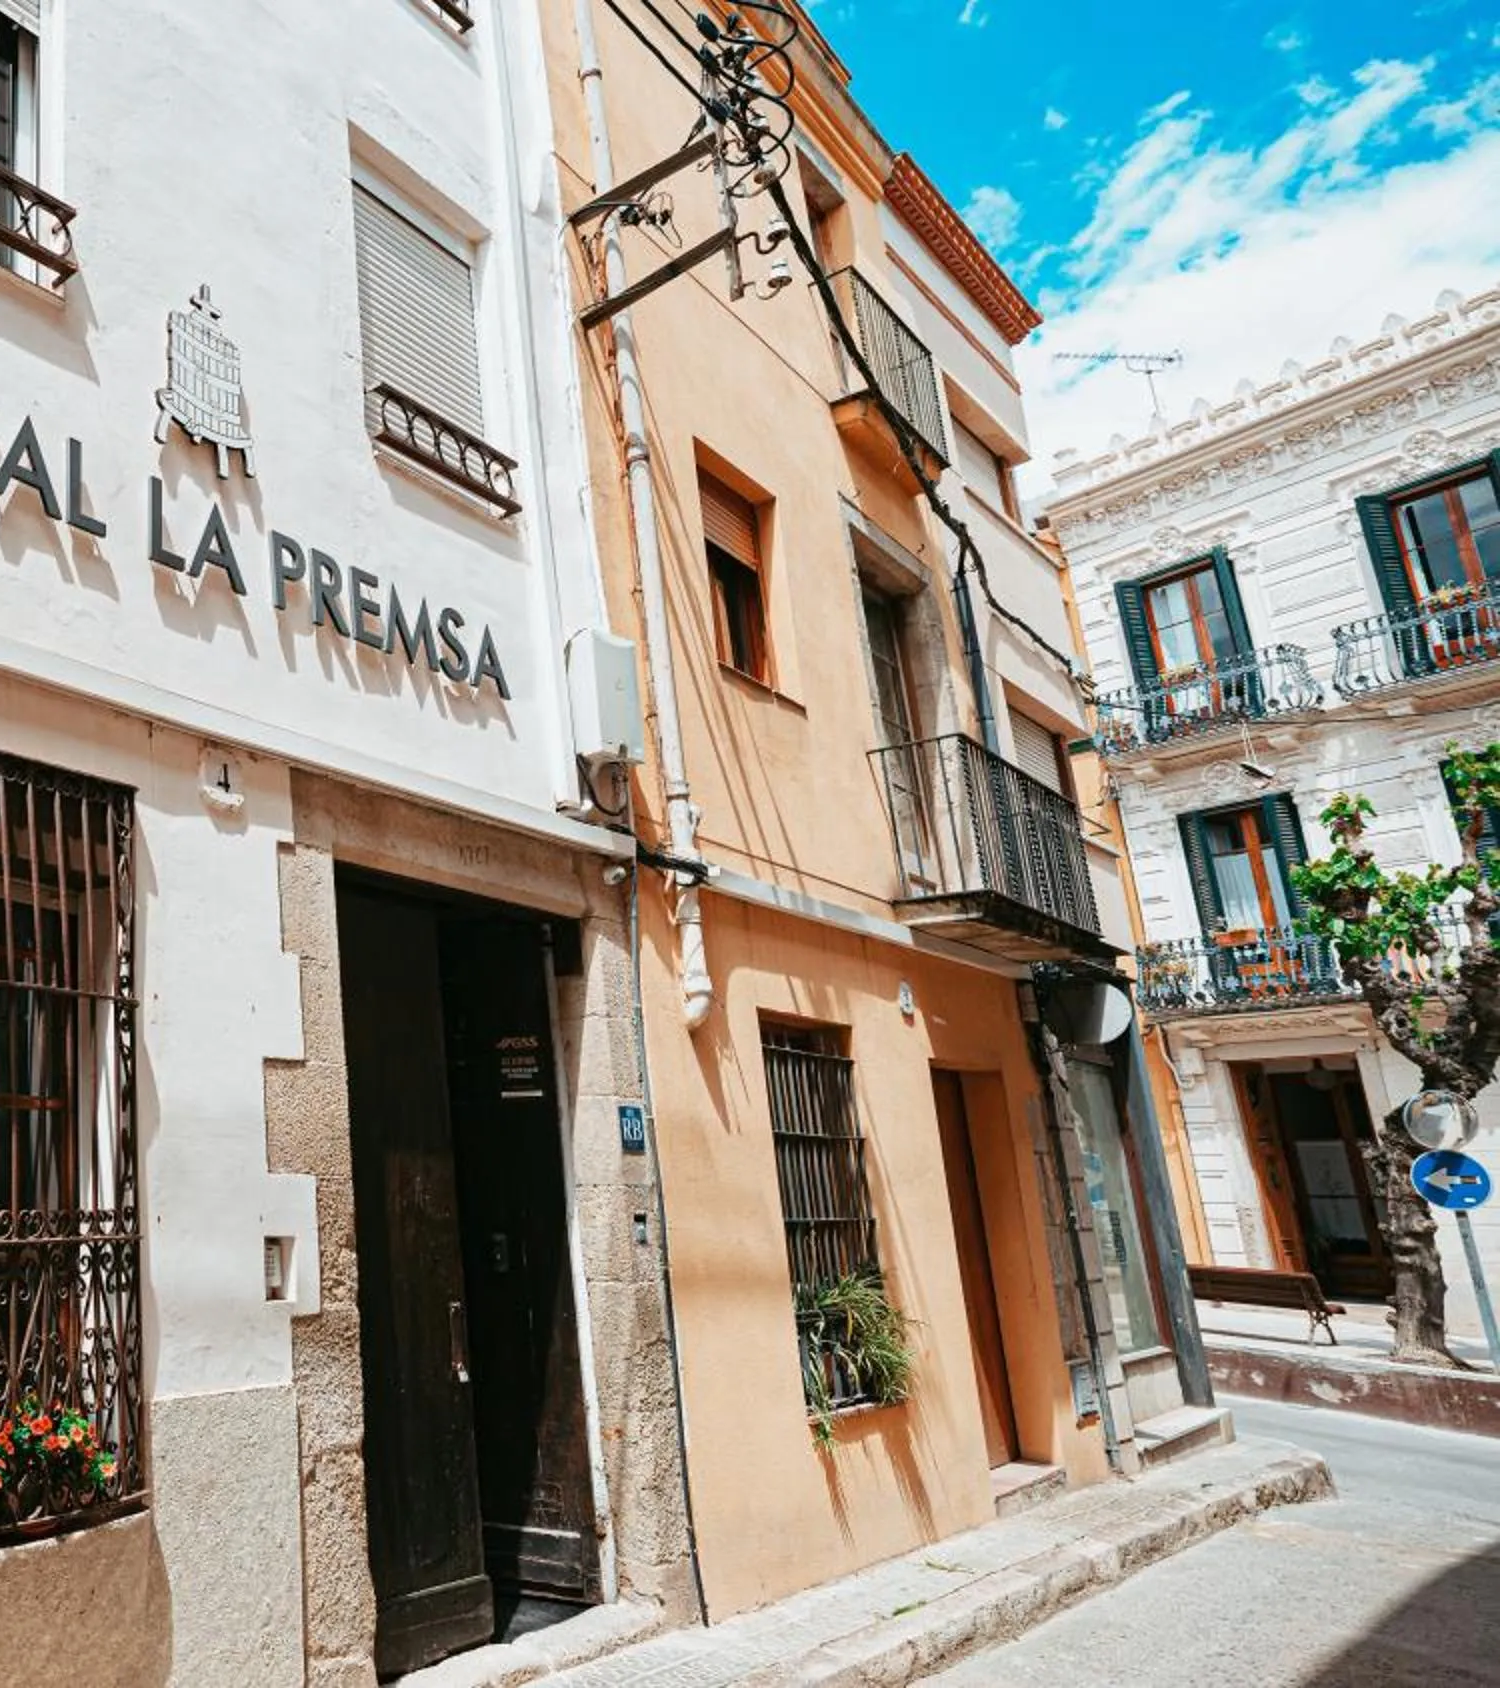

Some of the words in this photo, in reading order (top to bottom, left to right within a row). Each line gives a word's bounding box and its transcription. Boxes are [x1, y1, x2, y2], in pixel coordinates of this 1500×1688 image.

[147, 475, 247, 597] LA
[270, 529, 512, 701] PREMSA
[621, 1117, 644, 1141] RB
